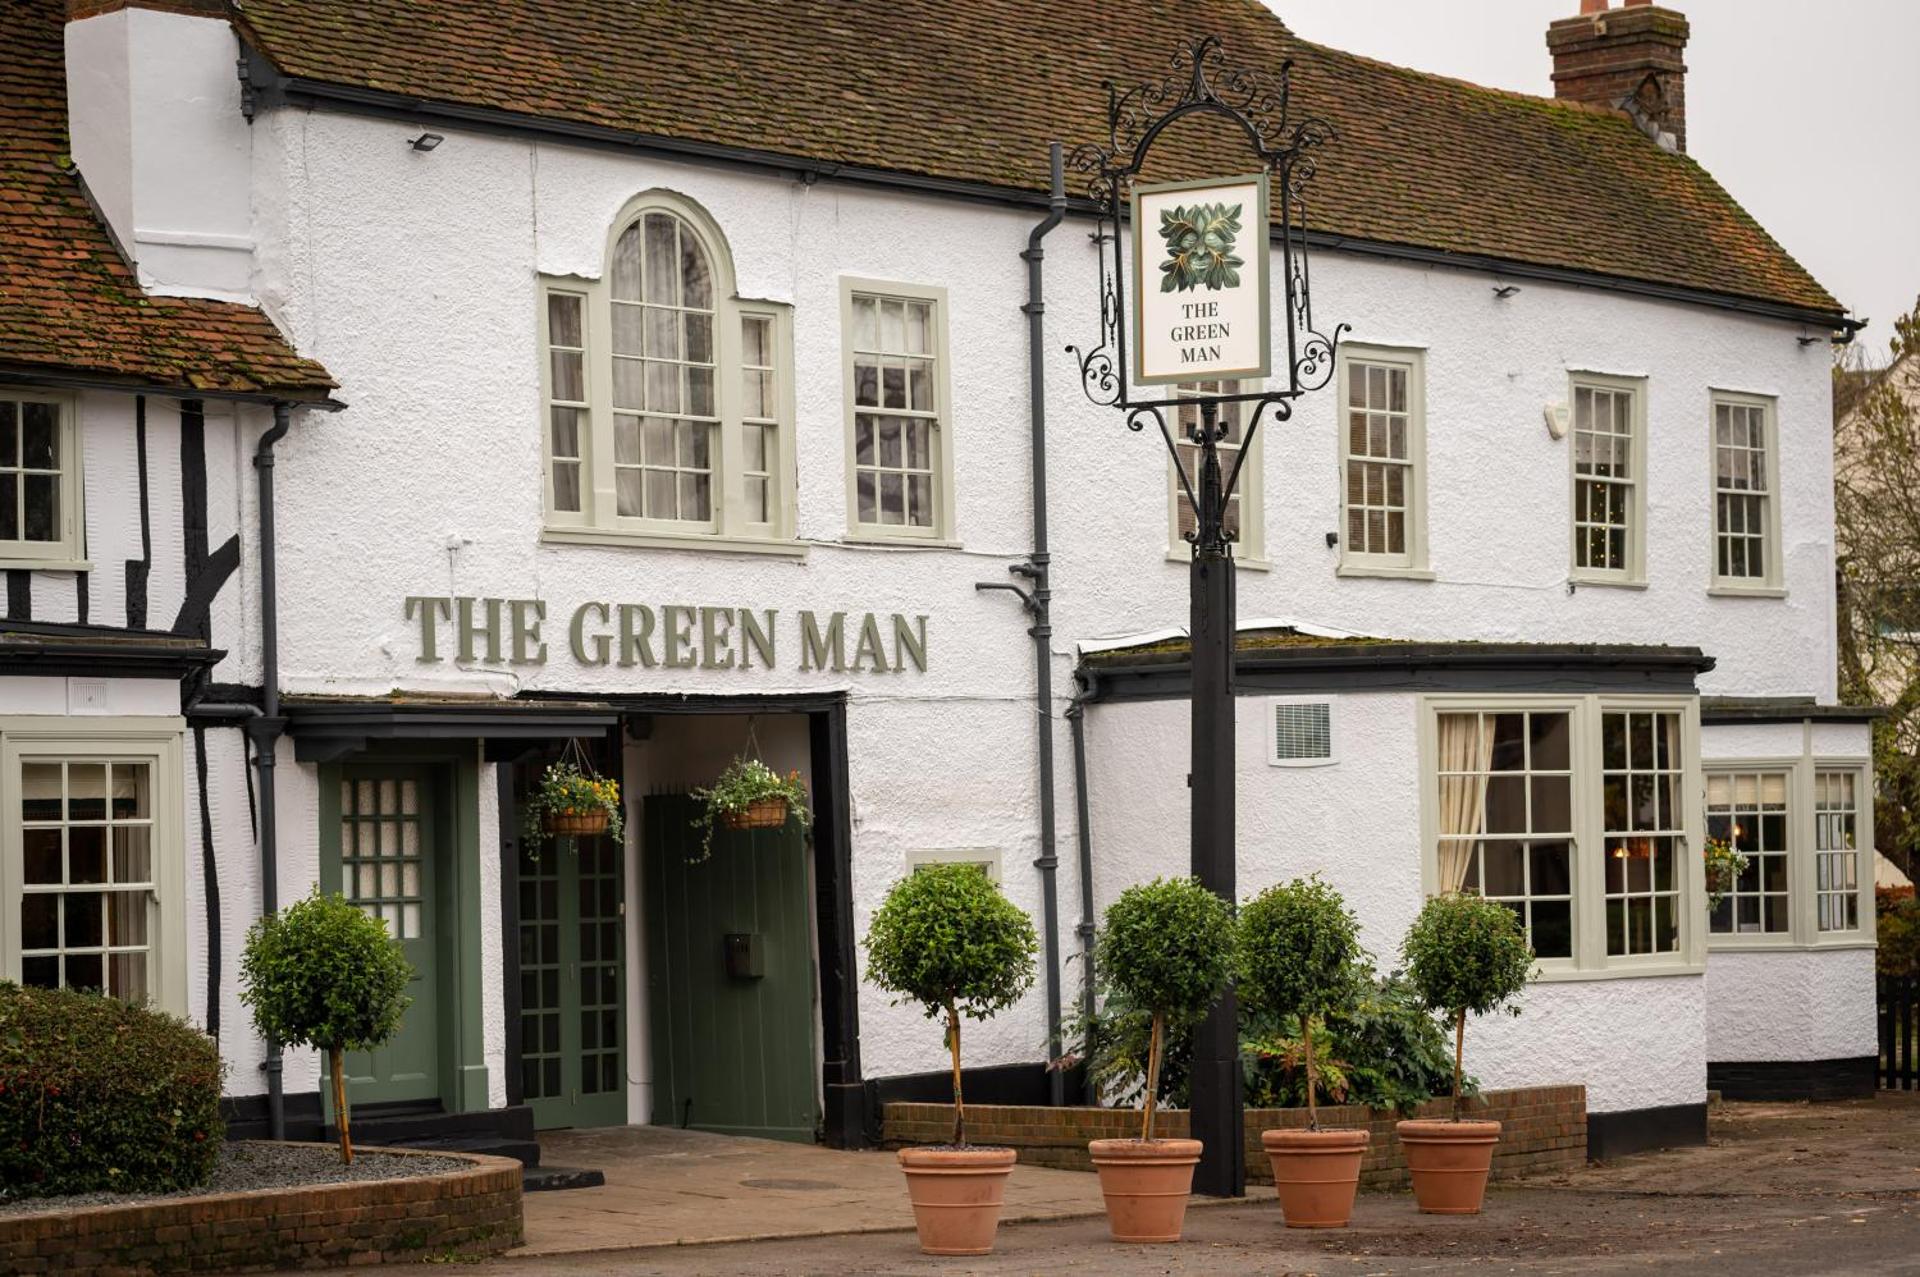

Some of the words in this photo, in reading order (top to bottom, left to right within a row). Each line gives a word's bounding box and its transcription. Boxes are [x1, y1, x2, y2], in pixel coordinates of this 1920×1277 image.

[1182, 302, 1218, 319] THE
[1171, 323, 1230, 342] GREEN
[1181, 345, 1221, 363] MAN
[405, 596, 548, 664] THE
[569, 601, 779, 669] GREEN
[799, 610, 930, 673] MAN
